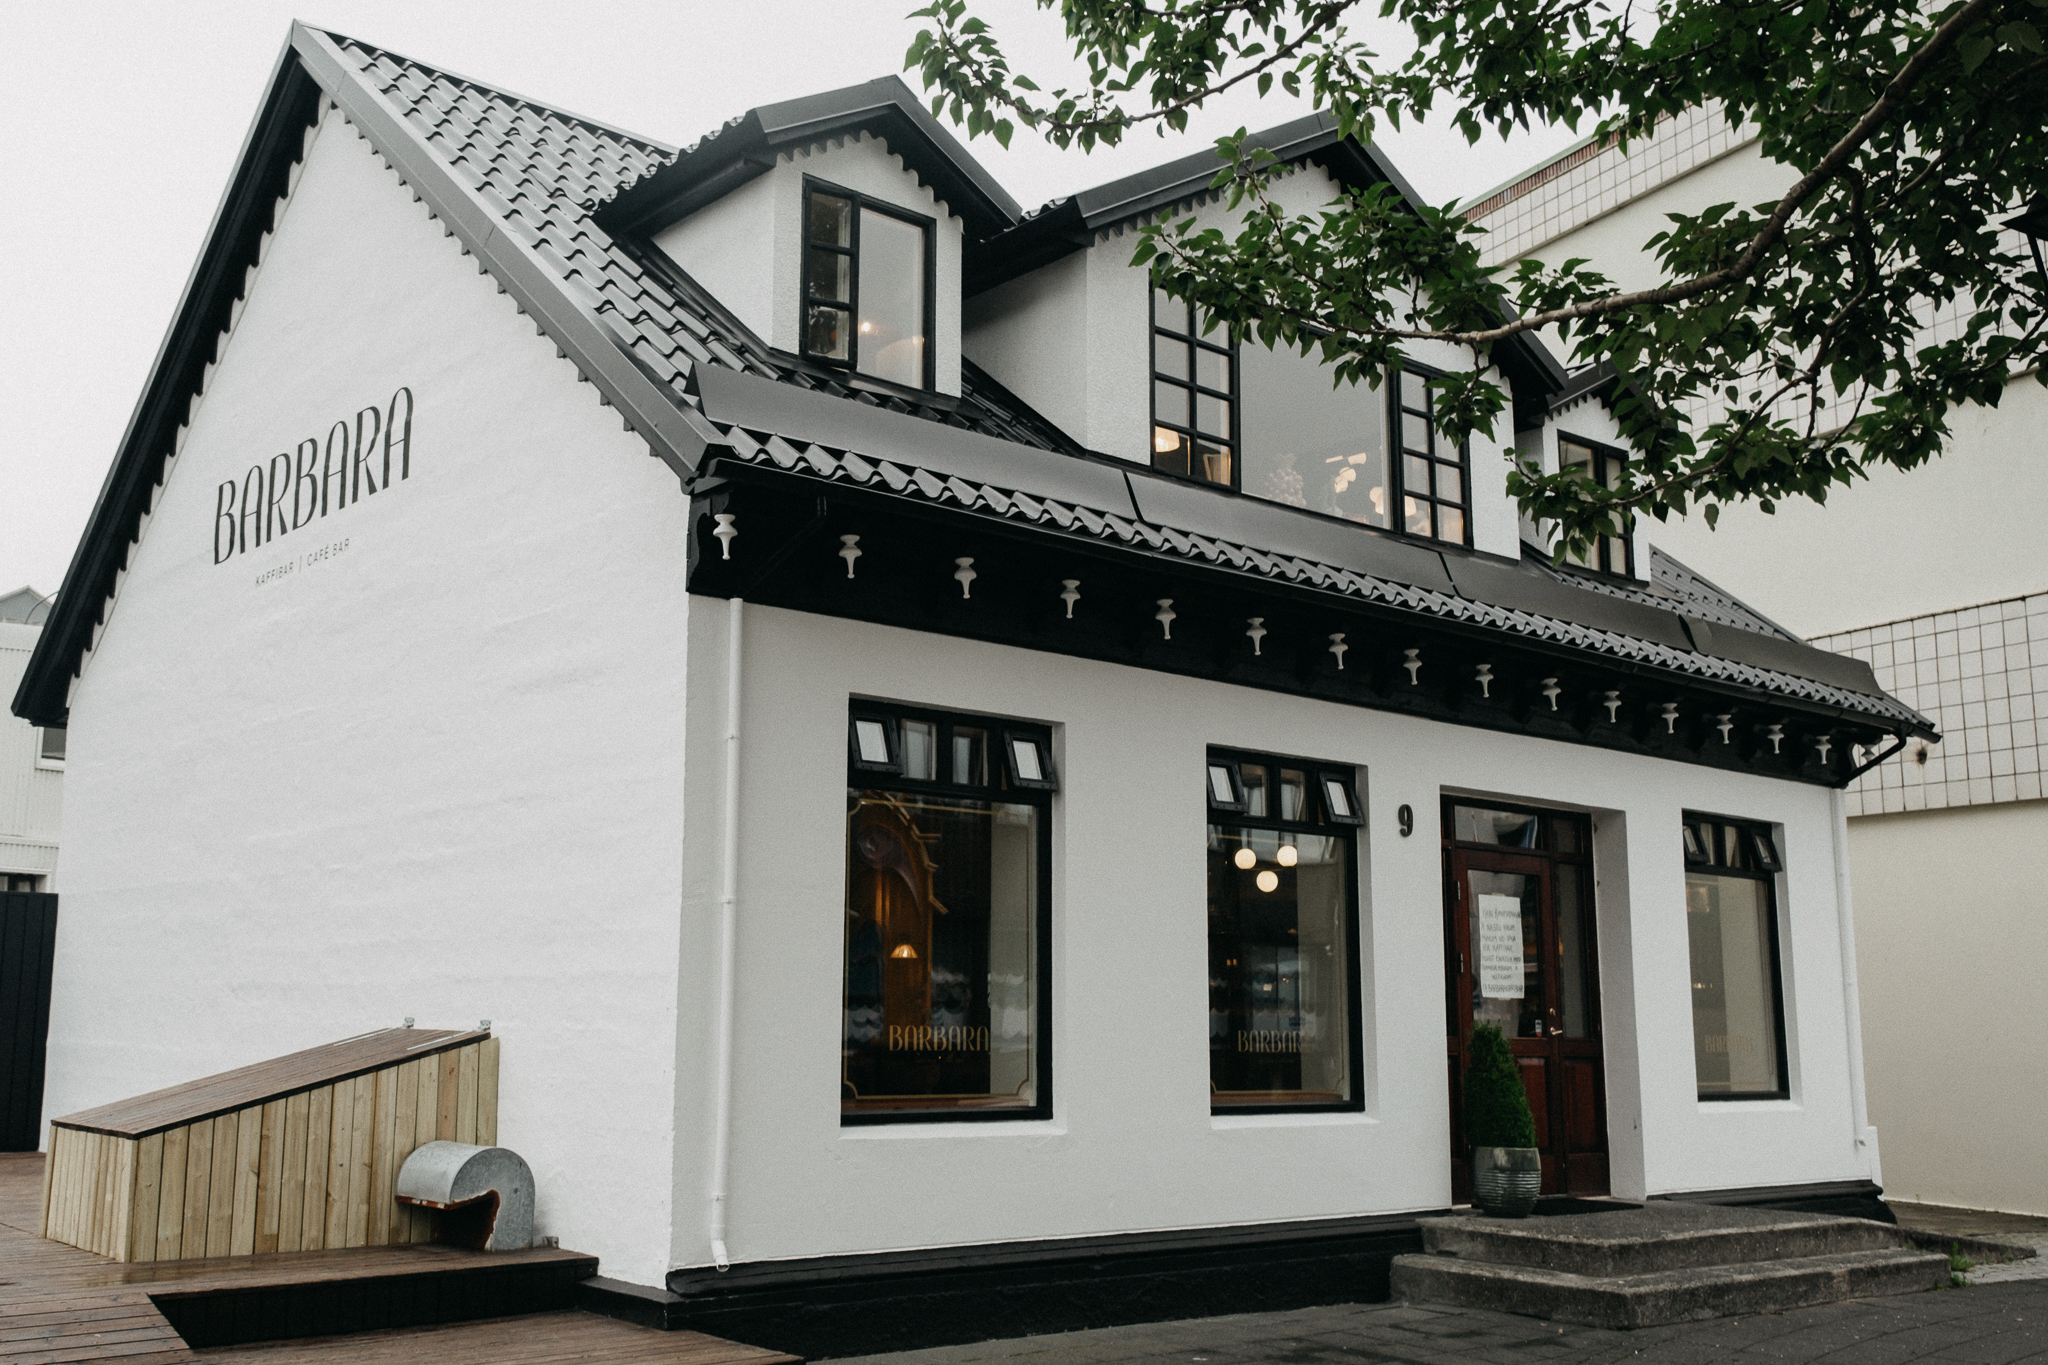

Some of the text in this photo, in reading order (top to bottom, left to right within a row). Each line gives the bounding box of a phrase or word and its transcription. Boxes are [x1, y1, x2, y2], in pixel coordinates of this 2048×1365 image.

[214, 386, 413, 565] BARBARA
[255, 561, 293, 587] KAFFIBAR
[333, 538, 349, 556] BAR
[1398, 803, 1413, 837] 9
[889, 1024, 989, 1051] BARBARA
[1238, 1029, 1311, 1053] BARBAR
